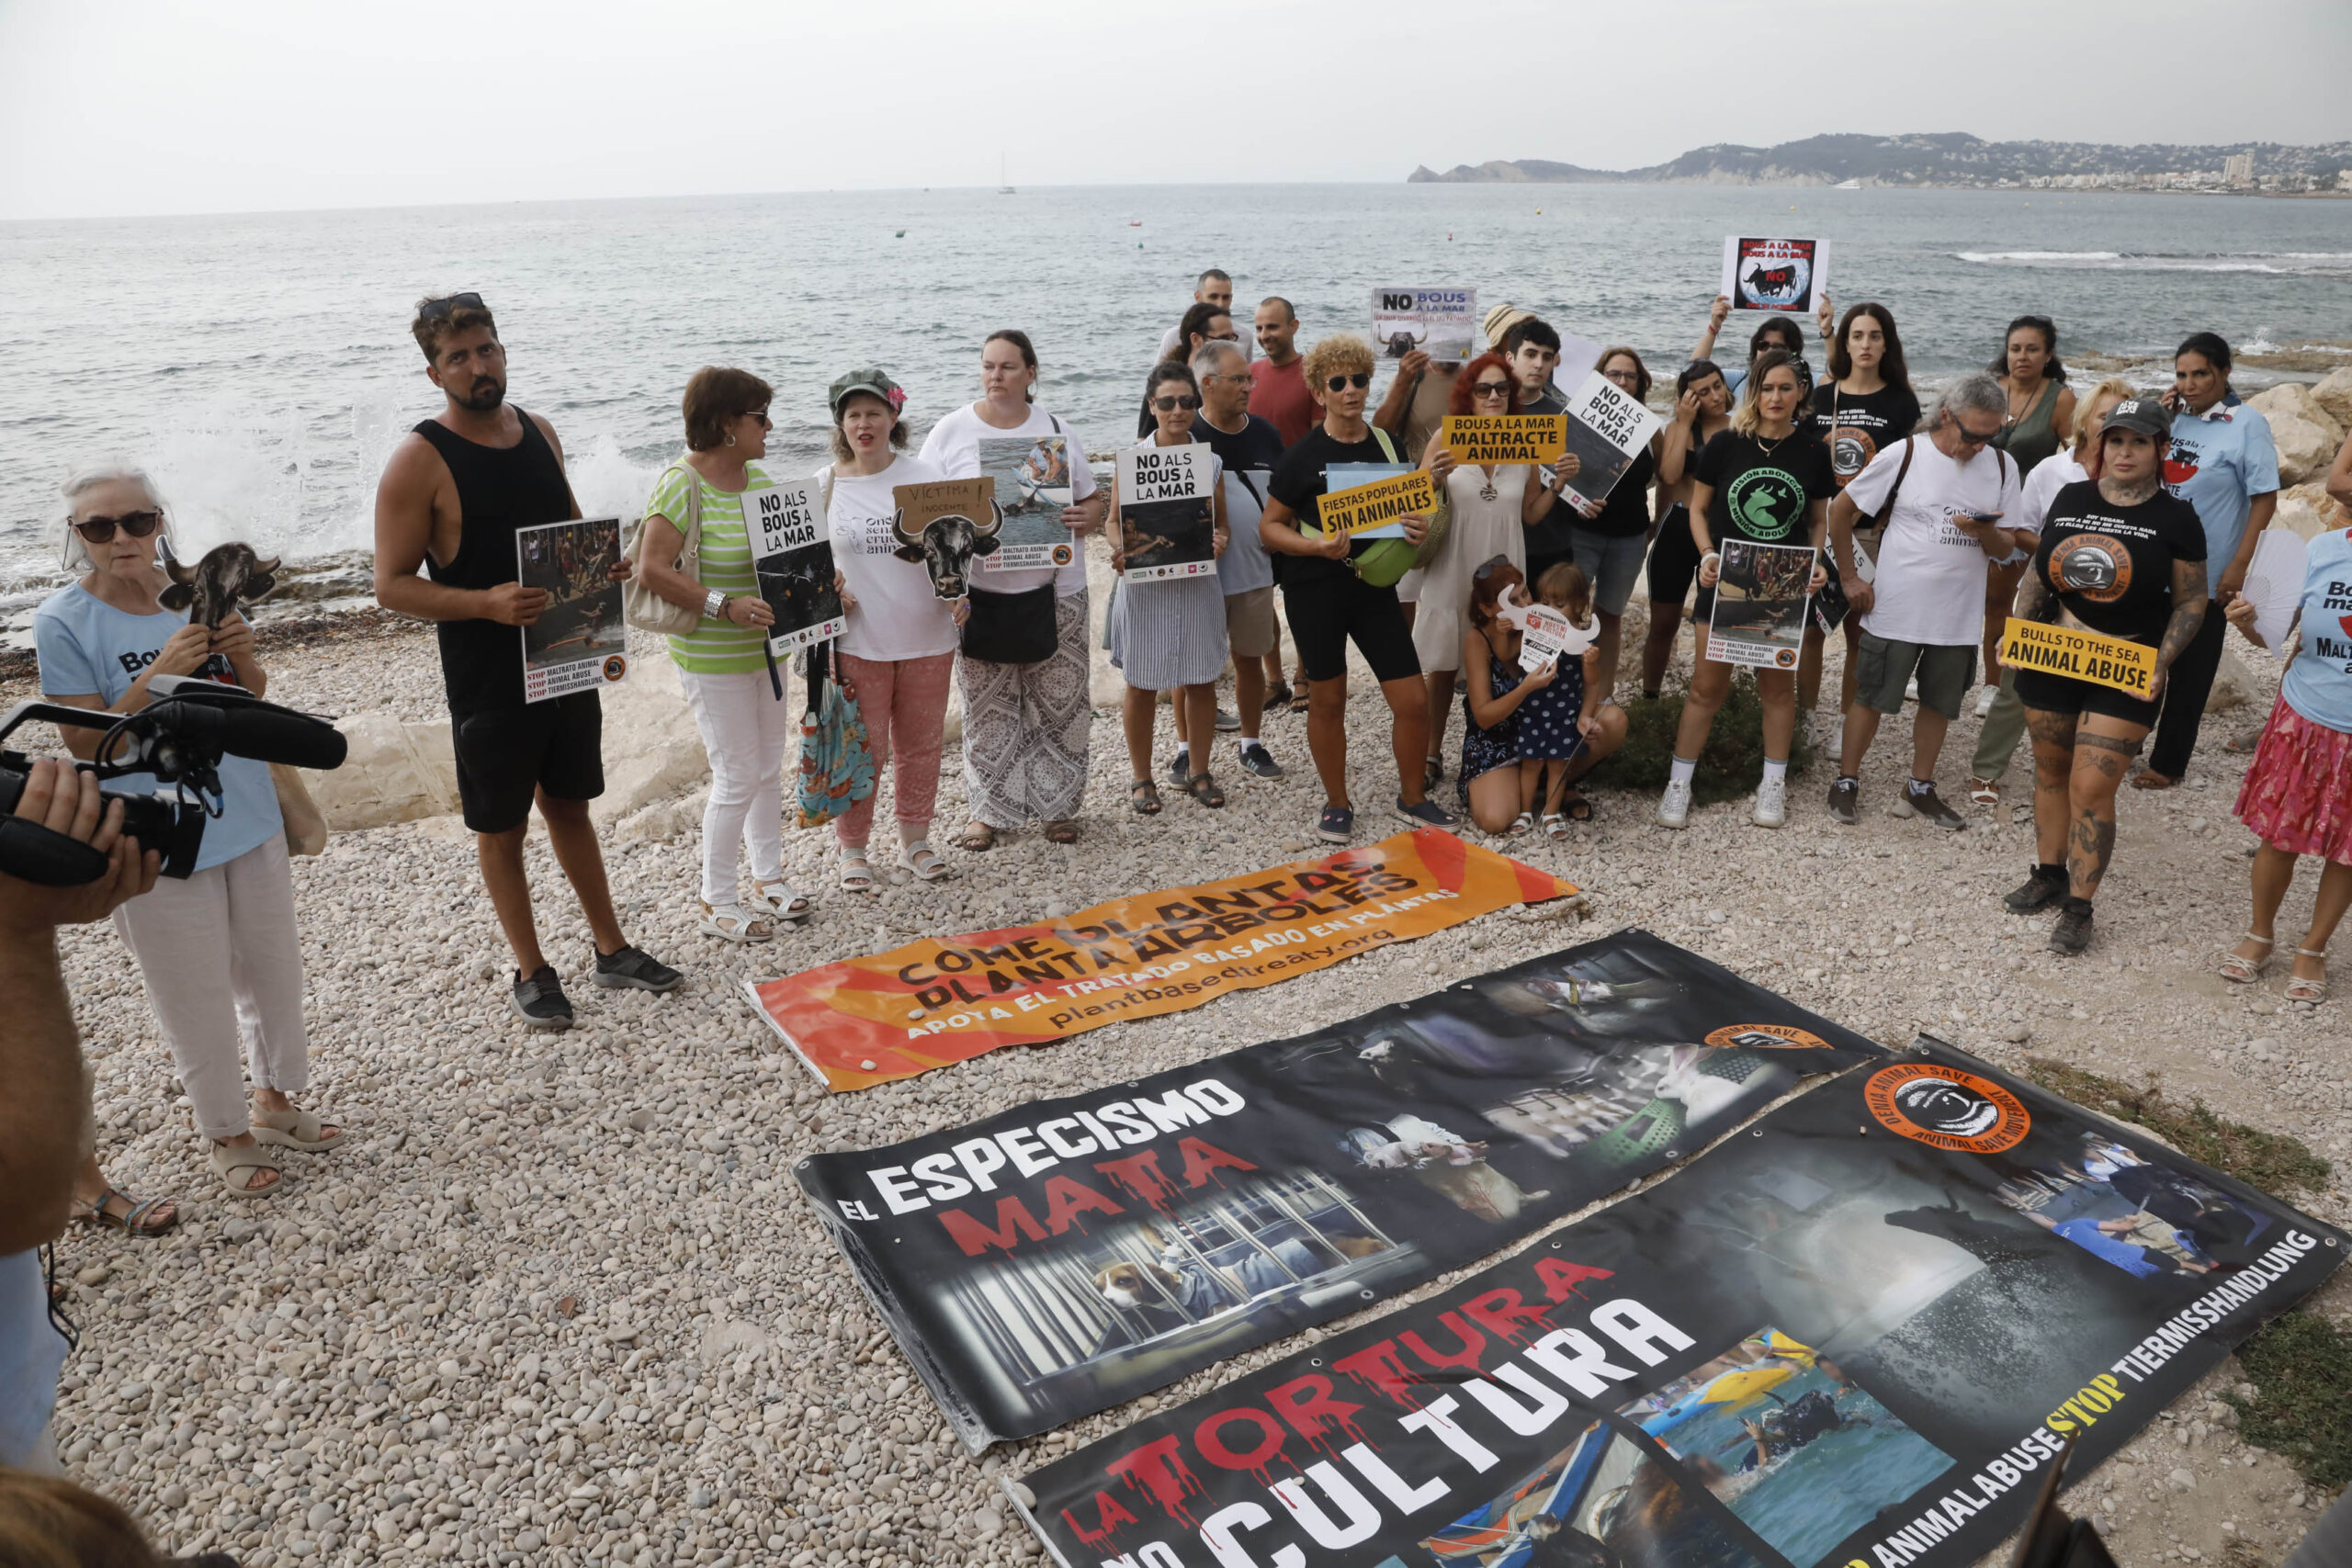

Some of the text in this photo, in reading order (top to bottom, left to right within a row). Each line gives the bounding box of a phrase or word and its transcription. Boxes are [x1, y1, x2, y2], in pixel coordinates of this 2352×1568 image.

[1766, 271, 1786, 282] NO
[1383, 292, 1466, 310] NO BOUS
[1589, 396, 1635, 436] BOUS A
[1599, 386, 1644, 424] NO ALS
[1454, 418, 1555, 430] BOUS A LA MAR
[1580, 408, 1629, 447] LA MAR
[1451, 431, 1557, 446] MALTRACTE
[1136, 453, 1192, 469] NO ALS
[1467, 446, 1540, 459] ANIMAL
[1136, 468, 1194, 485] BOUS A
[759, 491, 807, 513] NO ALS
[1136, 482, 1195, 500] LA MAR
[1323, 476, 1428, 513] FIESTAS POPULARES
[762, 509, 812, 533] BOUS A
[1327, 490, 1431, 533] SIN ANIMALES
[765, 525, 816, 552] LA MAR
[2133, 531, 2149, 540] VIDA
[1002, 553, 1023, 561] ANIMAL
[1727, 641, 1753, 651] MALTRATO
[2020, 626, 2141, 663] BULLS TO THE SEA
[526, 659, 600, 682] STOP MALTRATO ANIMAL
[2007, 640, 2148, 690] ANIMAL ABUSE
[527, 670, 591, 690] STOP ANIMAL ABUSE
[528, 676, 604, 699] STOP TIERMISSHANDLUNG
[899, 860, 1385, 986] COME PLANTAS
[907, 888, 1460, 1041] APOYA EL TRATADO BASADO EN PLANTAS
[914, 948, 1129, 1011] PLANTA
[1048, 928, 1396, 1030] plantbasedtreaty.org
[1764, 1026, 1800, 1039] SAVE
[1877, 1066, 1926, 1091] ANIMAL
[1929, 1066, 1973, 1084] SAVE
[836, 1078, 1246, 1222] EL ESPECISMO
[1913, 1131, 1976, 1151] ANIMAL
[1975, 1133, 2013, 1152] SAVE
[936, 1137, 1260, 1257] MATA
[1060, 1256, 1615, 1544] LA TORTURA
[1871, 1229, 2317, 1568] ANIMAL ABUSE STOP TIERMISSHANDLUNG
[1199, 1298, 1696, 1568] CULTURA
